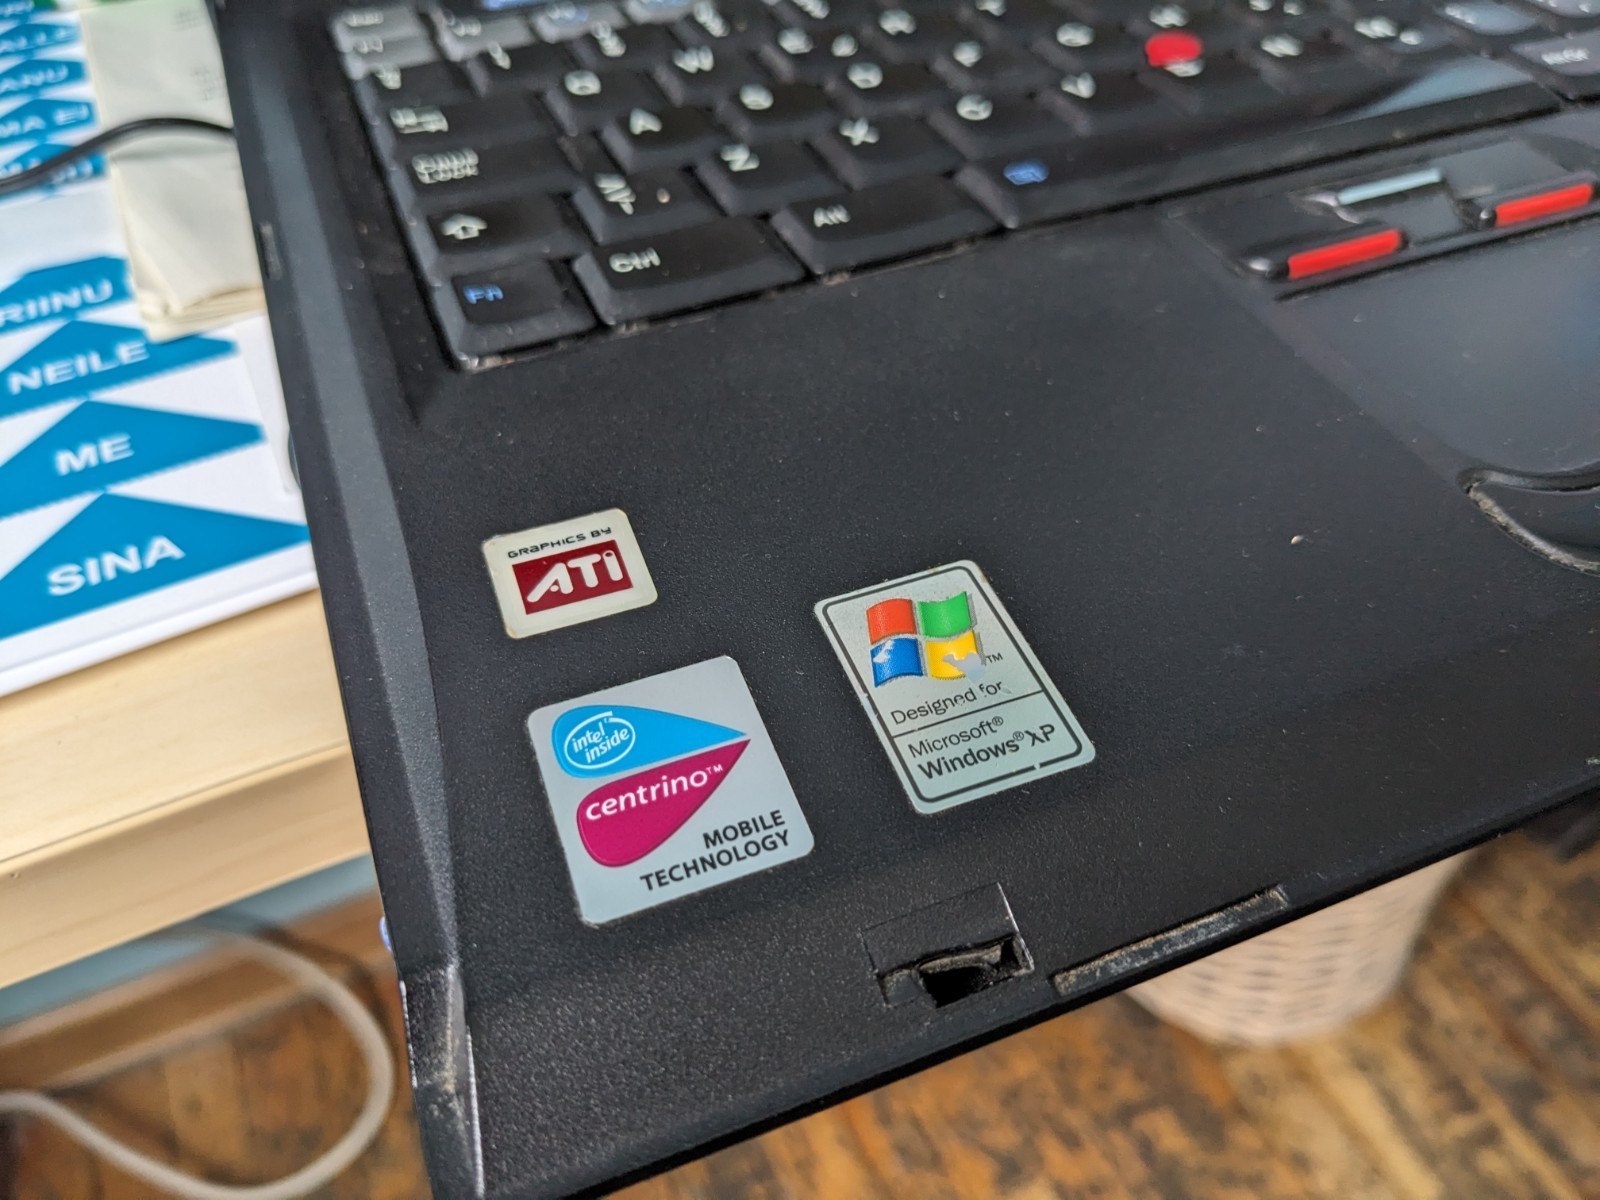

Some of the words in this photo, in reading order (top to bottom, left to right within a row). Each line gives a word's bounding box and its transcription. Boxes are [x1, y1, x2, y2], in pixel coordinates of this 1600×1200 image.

[629, 107, 662, 135] A
[720, 142, 760, 172] Z
[608, 247, 661, 273] Ctrl
[463, 284, 504, 305] Fn
[7, 339, 150, 395] NEILE
[54, 432, 135, 477] ME
[46, 534, 186, 597] SINA
[889, 687, 978, 726] Designed
[978, 681, 1003, 699] for
[571, 721, 606, 753] intel
[584, 728, 631, 764] inside
[1024, 723, 1056, 747] XP
[701, 809, 787, 850] MOBILE
[639, 829, 790, 892] TECHNOLOGY
